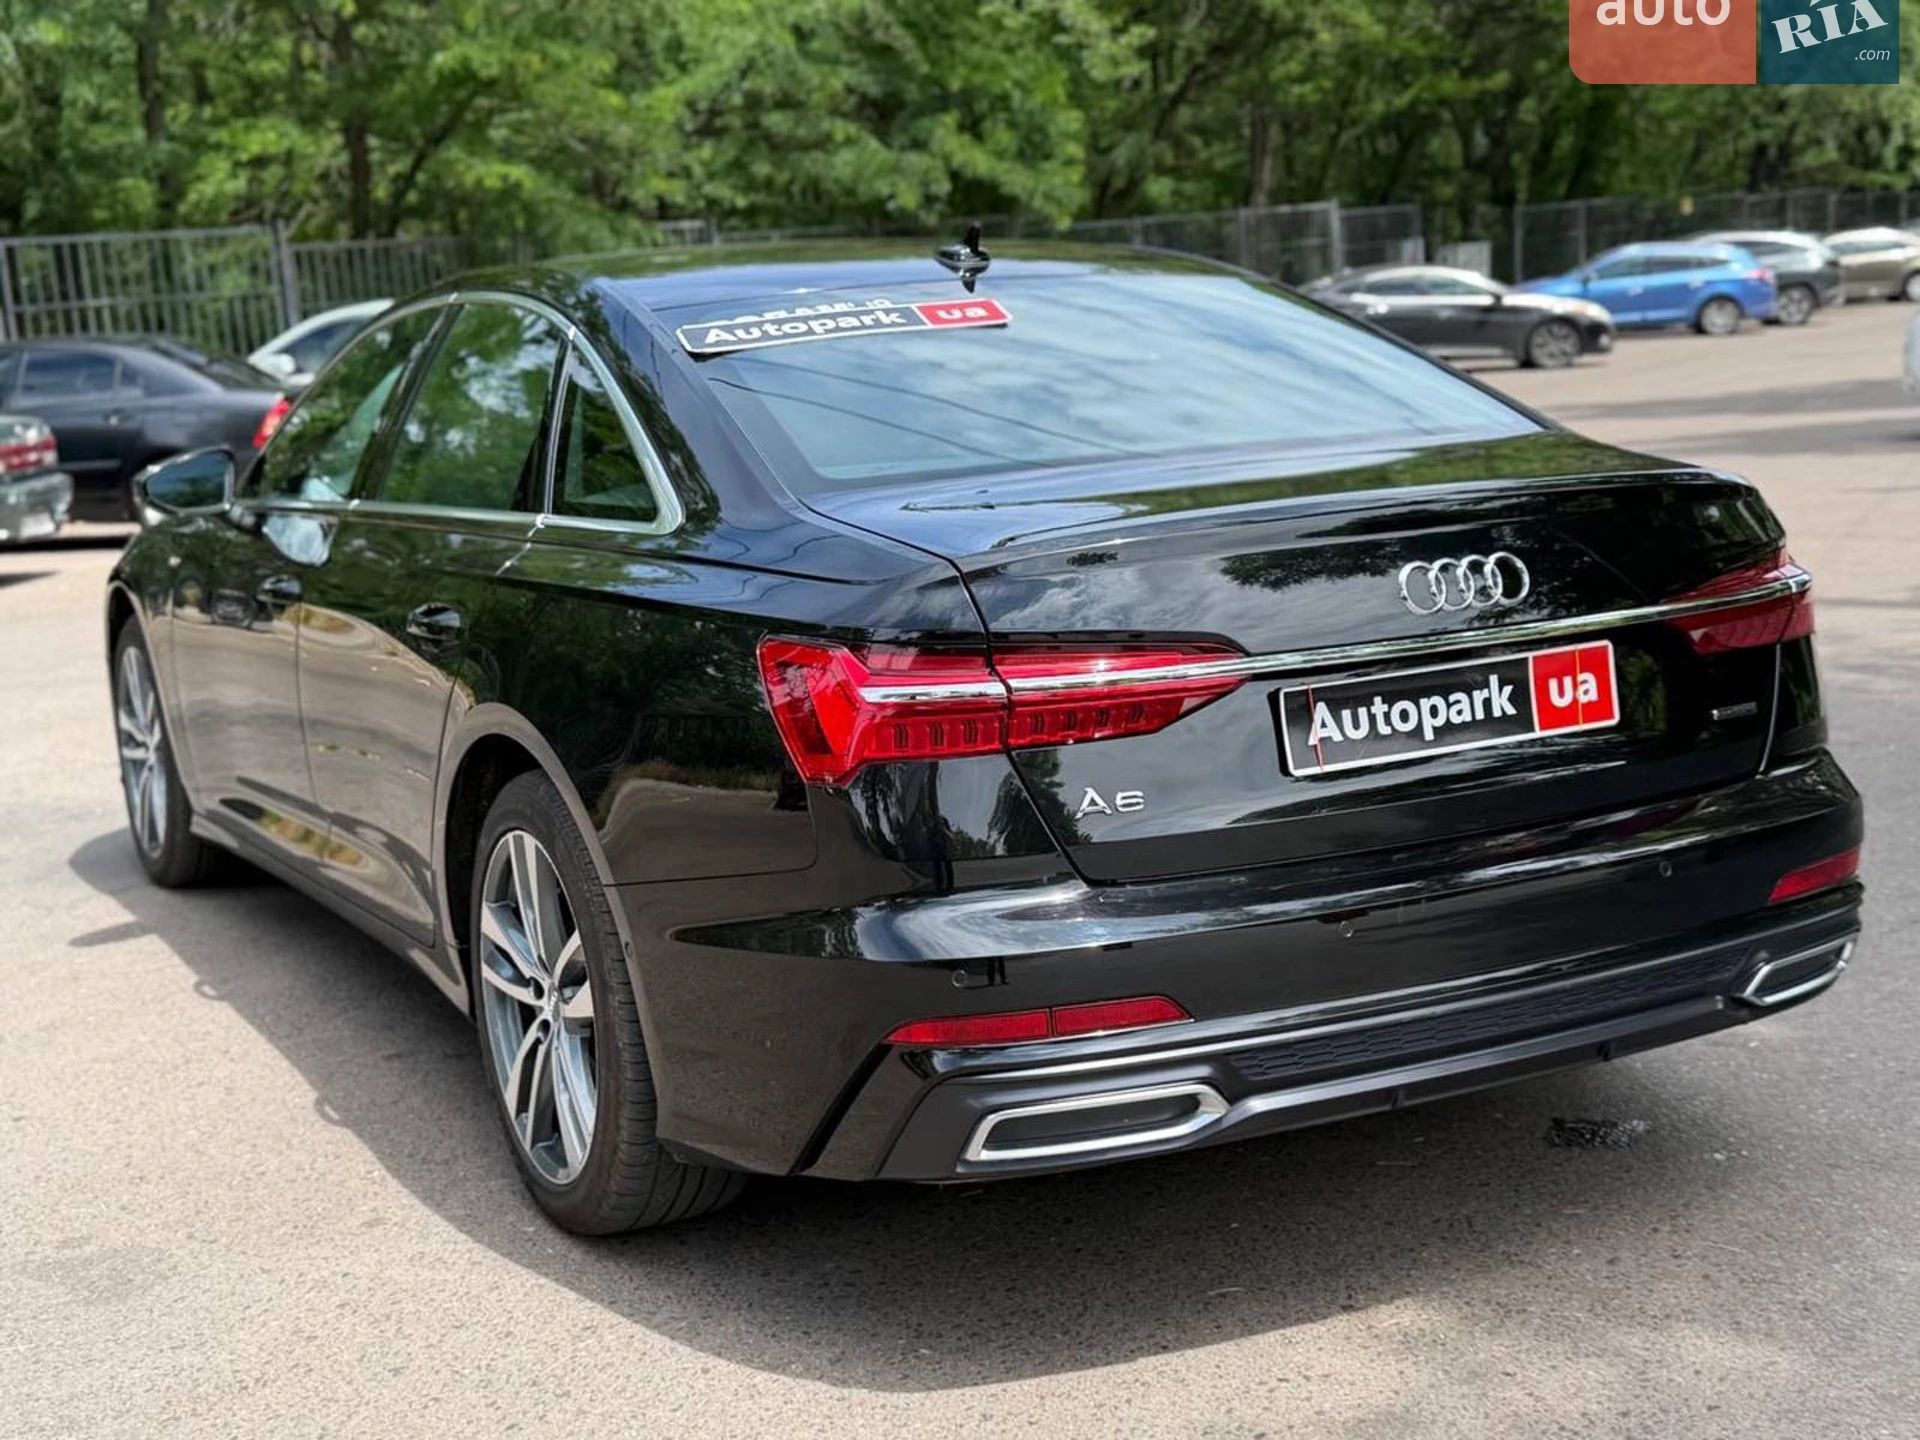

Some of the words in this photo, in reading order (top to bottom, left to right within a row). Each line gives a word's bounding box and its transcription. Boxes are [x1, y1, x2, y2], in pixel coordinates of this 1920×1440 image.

[704, 309, 907, 345] Autopark
[936, 306, 990, 321] ua
[1307, 674, 1518, 746] Autopark
[1548, 672, 1598, 708] ua
[1075, 787, 1145, 819] A6
